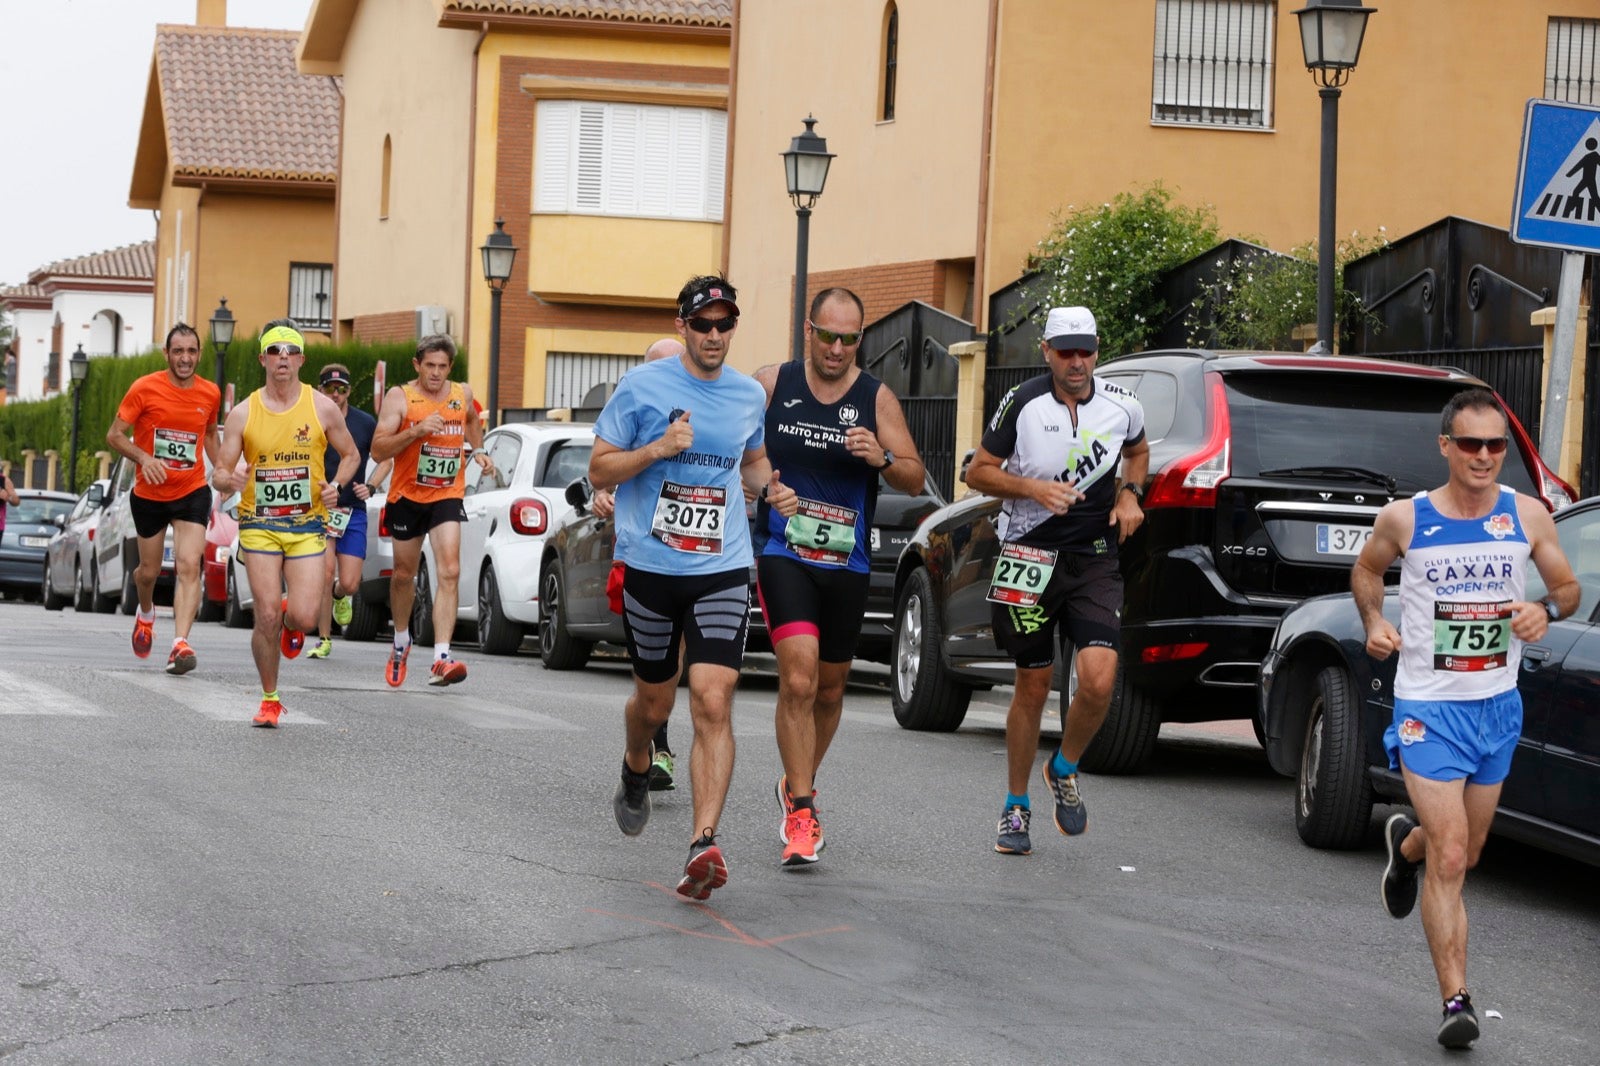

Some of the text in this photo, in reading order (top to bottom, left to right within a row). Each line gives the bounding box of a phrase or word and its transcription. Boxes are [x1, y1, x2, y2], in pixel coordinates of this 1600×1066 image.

[843, 407, 855, 420] 30
[778, 423, 812, 438] PAZITO
[814, 432, 820, 440] a
[168, 442, 187, 458] 82
[804, 439, 827, 449] Motril
[274, 451, 310, 463] Vigilsa
[1054, 439, 1108, 487] CHA
[426, 459, 456, 475] 310
[264, 483, 302, 502] 946
[664, 503, 719, 531] 3073
[814, 524, 831, 545] 5
[1425, 555, 1514, 568] CLUB ATLETISMO
[997, 560, 1041, 588] 279
[1426, 563, 1512, 582] CAXAR
[1453, 603, 1467, 613] GRAN
[1468, 603, 1488, 613] PREMIO
[1448, 624, 1502, 651] 752
